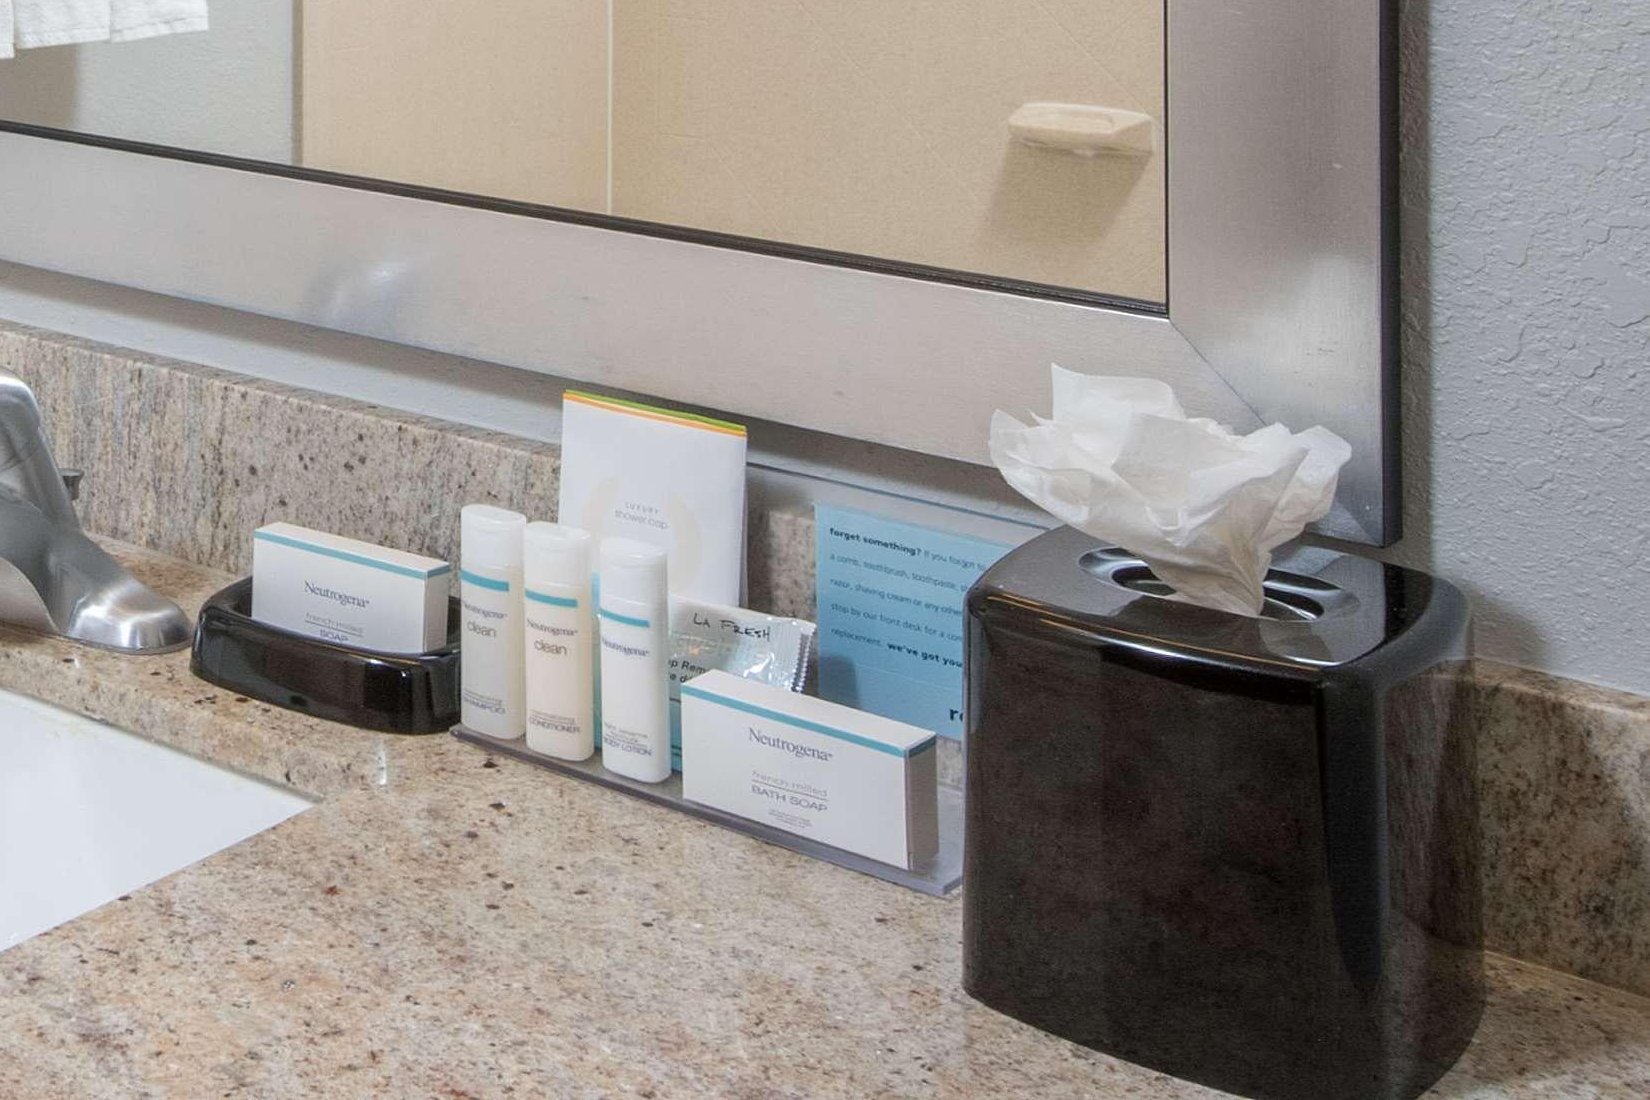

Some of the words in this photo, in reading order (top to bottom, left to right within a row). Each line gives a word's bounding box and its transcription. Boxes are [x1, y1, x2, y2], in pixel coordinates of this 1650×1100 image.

[830, 527, 860, 541] forget
[863, 536, 922, 556] something?
[931, 552, 947, 562] you
[304, 579, 367, 608] Neutrogena
[467, 620, 497, 639] clean
[693, 612, 711, 628] LA
[720, 619, 771, 642] FRESH
[831, 602, 850, 615] stop
[851, 606, 861, 618] by
[863, 611, 878, 620] our
[903, 619, 922, 632] desk
[924, 625, 937, 635] for
[534, 639, 568, 656] clean
[887, 642, 918, 656] we've
[921, 650, 940, 662] got
[749, 726, 830, 761] Neutrogena
[751, 784, 787, 802] BATH
[789, 795, 828, 812] SOAP
